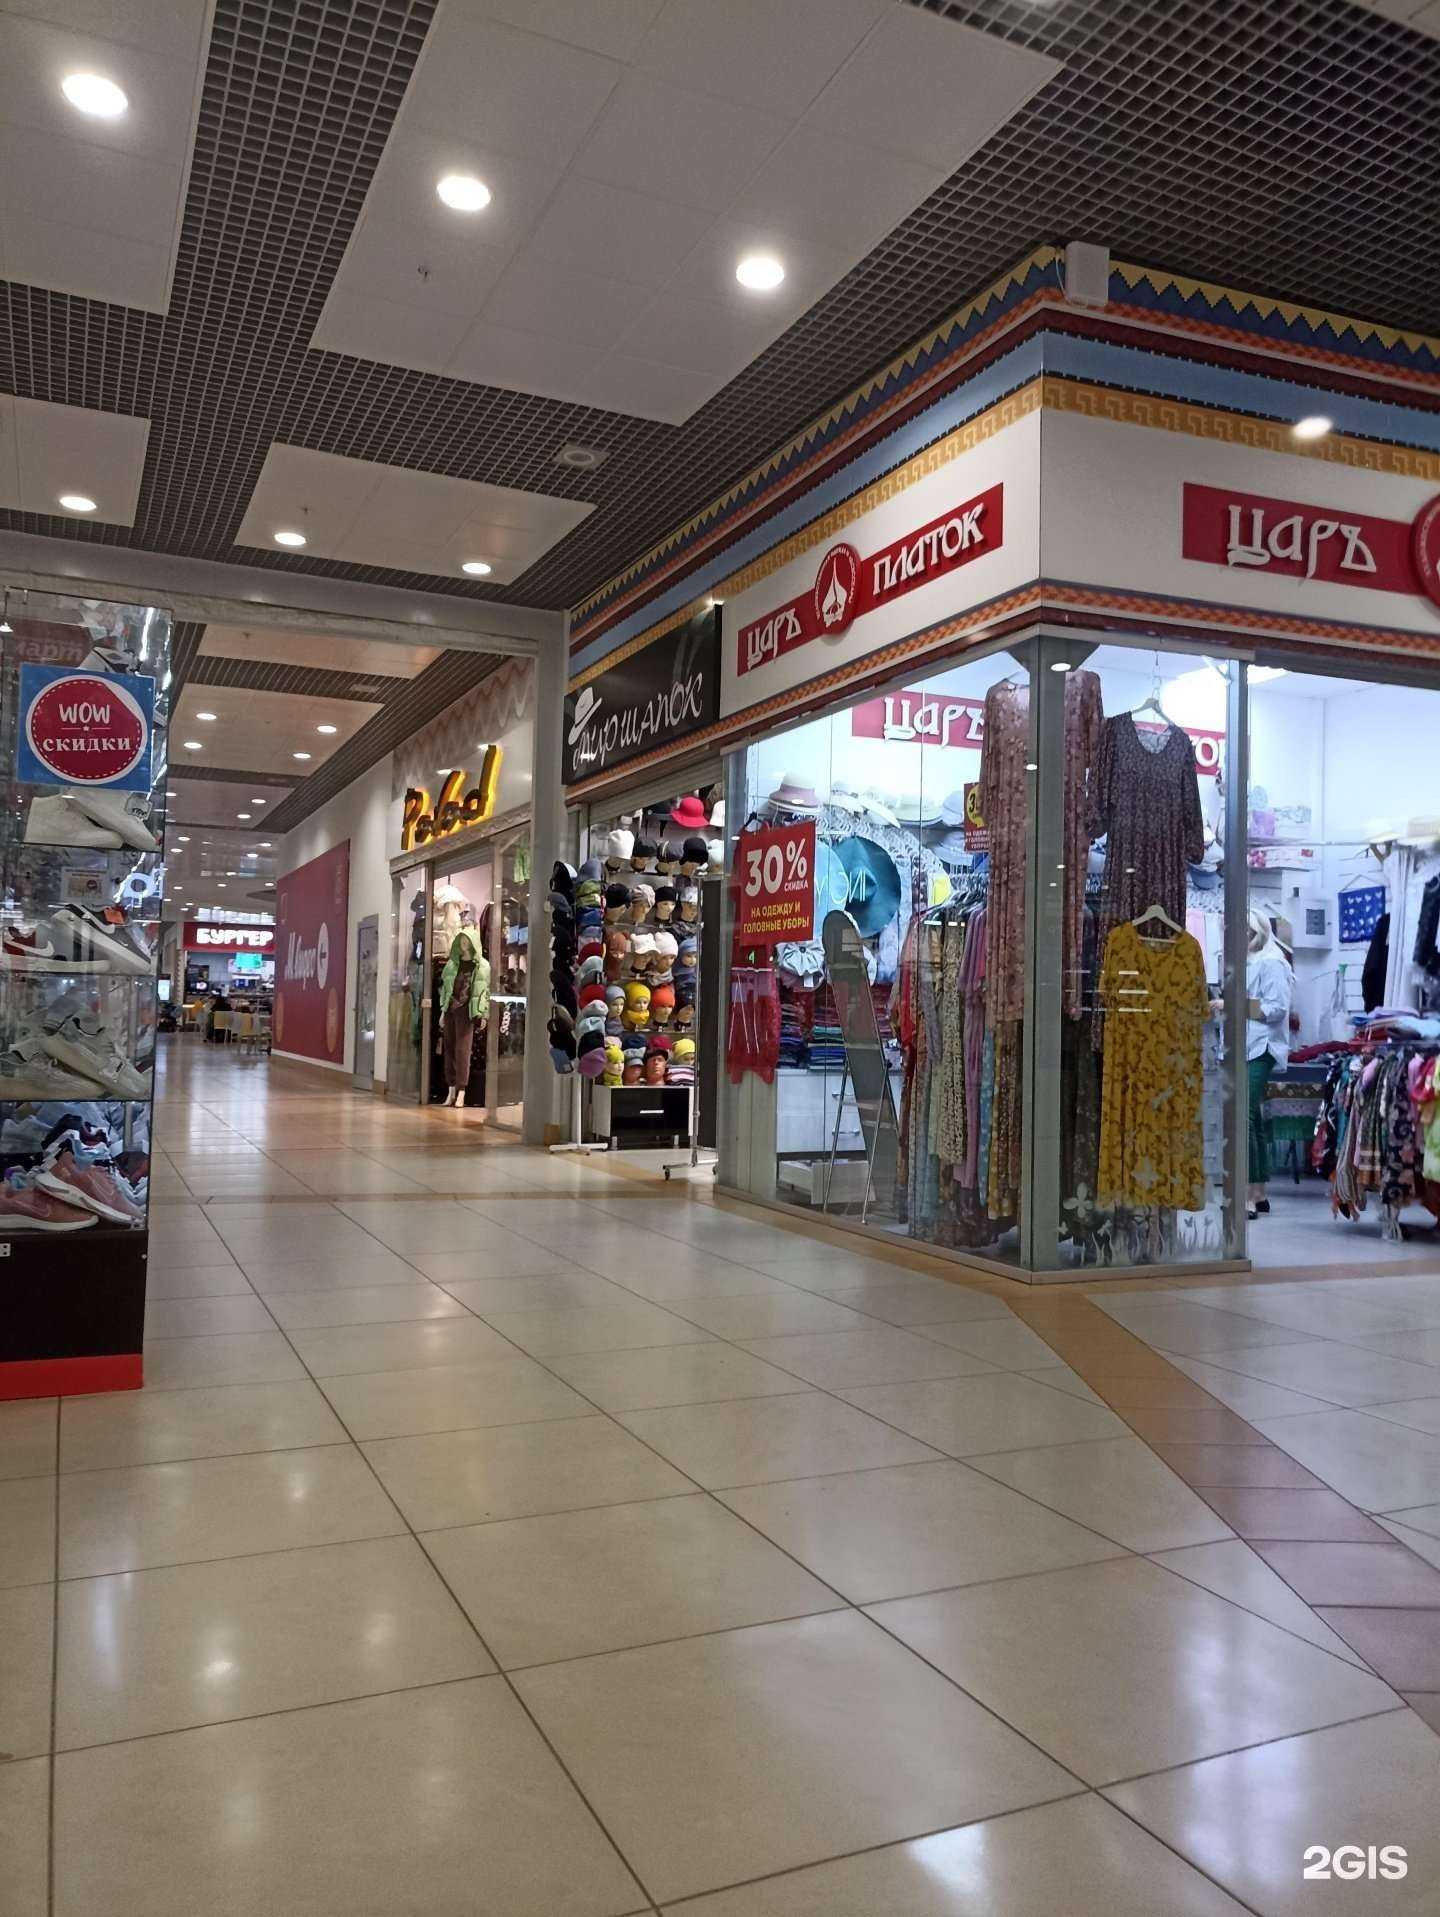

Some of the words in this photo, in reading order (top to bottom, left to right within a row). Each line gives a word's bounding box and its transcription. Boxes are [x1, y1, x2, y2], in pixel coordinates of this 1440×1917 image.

[58, 702, 111, 725] WOW
[745, 837, 808, 897] 30%
[784, 879, 809, 893] СКИДКА
[751, 906, 761, 918] НА
[762, 902, 793, 918] ОДЕЖДУ
[794, 901, 801, 912] И
[744, 918, 782, 933] ГОЛОВНЫЕ
[782, 917, 810, 931] УБОРЫ
[196, 927, 274, 947] БУРГЕР
